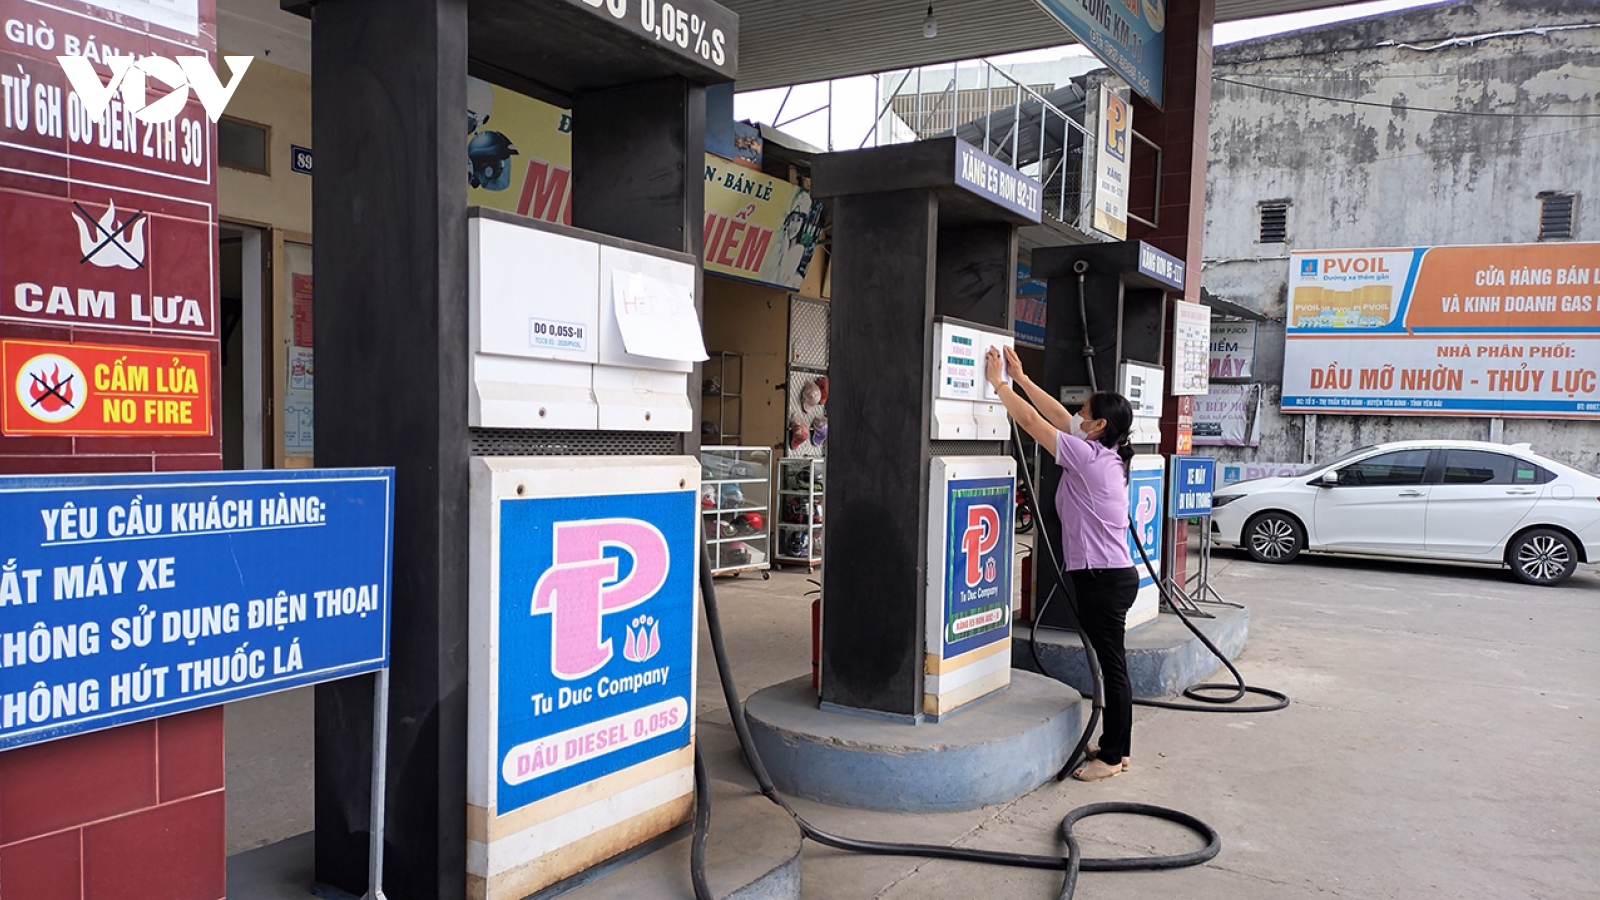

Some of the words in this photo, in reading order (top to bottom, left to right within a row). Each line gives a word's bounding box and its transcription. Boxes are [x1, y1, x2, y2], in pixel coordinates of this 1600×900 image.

[5, 17, 55, 50] GIỜ
[640, 0, 726, 66] 0,05%S
[1113, 13, 1130, 51] KM
[1132, 32, 1143, 63] 11
[1, 64, 31, 131] TỪ
[34, 83, 63, 139] 6H
[181, 117, 202, 168] 30
[723, 165, 755, 195] BÁN
[755, 182, 773, 201] LẺ
[962, 148, 986, 188] XĂNG
[987, 164, 999, 194] E5
[999, 170, 1017, 203] RON
[1141, 246, 1156, 272] XĂNG
[1323, 257, 1390, 273] PVOIL
[1475, 264, 1506, 287] CỬA
[1509, 266, 1552, 286] HÀNG
[1556, 265, 1590, 285] BÁN
[14, 282, 116, 320] CAM
[131, 293, 205, 327] LƯA
[1441, 293, 1461, 313] VÀ
[1464, 296, 1501, 313] KINH
[1504, 295, 1558, 313] DOANH
[1561, 295, 1593, 312] GAS
[534, 322, 547, 334] DO
[1437, 343, 1471, 358] NHÀ
[1477, 343, 1522, 358] PHÂN
[1529, 342, 1576, 358] PHỐI:
[94, 355, 149, 392] CẤM
[156, 357, 199, 393] LỬA
[1310, 361, 1352, 389] DẦU
[1359, 365, 1395, 390] MỠ
[1400, 365, 1464, 391] NHỜN
[1487, 362, 1544, 393] THỦY
[1551, 367, 1597, 398] LỰC
[103, 398, 137, 425] NO
[144, 400, 193, 425] FIRE
[41, 501, 98, 541] YÊU
[107, 494, 163, 537] CẦU
[171, 495, 252, 531] KHÁCH
[260, 492, 326, 526] HÀNG:
[54, 556, 128, 600] MÁY
[136, 557, 176, 591] XE
[0, 621, 100, 668] HÔNG
[111, 604, 156, 651] SỬ
[162, 602, 240, 646] DỤNG
[247, 590, 306, 631] ĐIỆN
[313, 584, 379, 619] THOẠI
[0, 680, 100, 730] HÔNG
[110, 663, 170, 708] HÚT
[177, 642, 265, 692] THUỐC
[273, 637, 303, 674] LÁ
[531, 693, 552, 716] Tu
[558, 684, 592, 712] Duc
[597, 666, 670, 699] Company
[516, 741, 559, 777] DẦU
[565, 723, 628, 762] DIESEL
[634, 706, 679, 738] 0,05S
